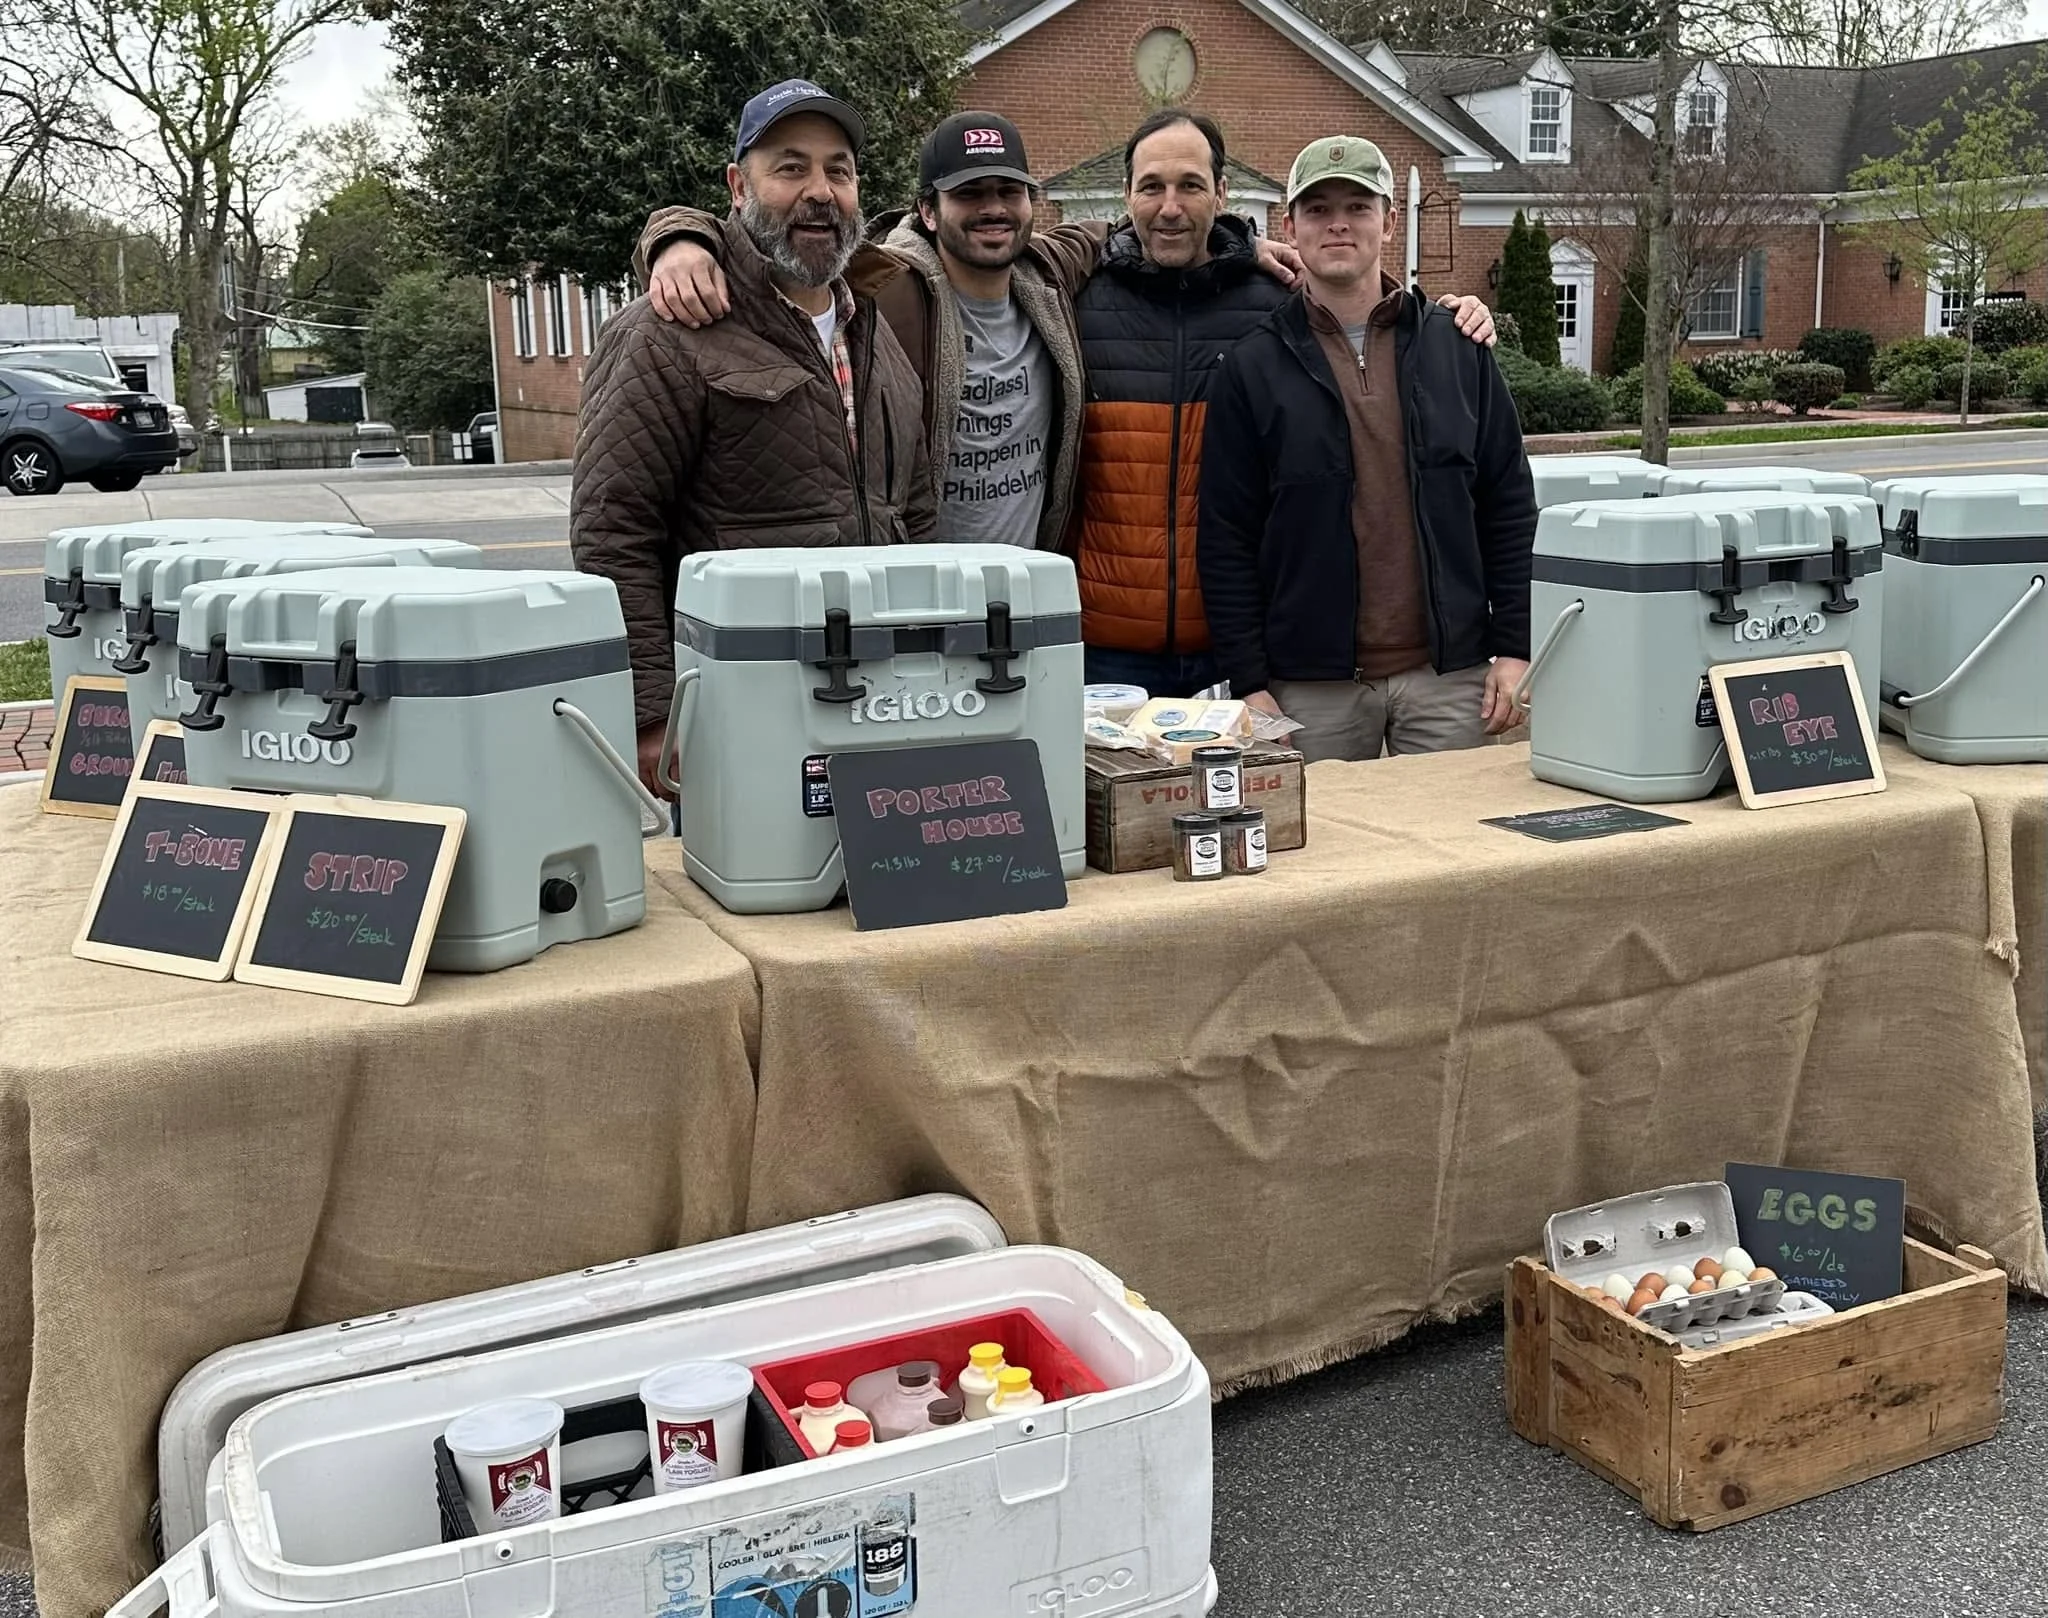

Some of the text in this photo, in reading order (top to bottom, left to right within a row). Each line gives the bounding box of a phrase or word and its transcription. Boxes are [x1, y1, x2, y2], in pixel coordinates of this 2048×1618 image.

[959, 365, 1029, 404] ad[ass]
[956, 408, 1013, 436] hings
[1025, 433, 1041, 455] in
[850, 689, 987, 724] IGLOO
[1749, 692, 1800, 726] RIB
[241, 729, 353, 767] IGLOO
[1783, 716, 1838, 747] EYE
[866, 775, 1012, 819] PORTER
[921, 811, 1025, 844] HOUSE
[145, 829, 246, 871] T-BONE
[303, 851, 409, 895] STRIP
[1757, 1188, 1878, 1232] EGGS
[1814, 1289, 1861, 1303] DAILY
[717, 1555, 755, 1570] COOLER
[813, 1531, 851, 1547] HIELERA
[1026, 1567, 1135, 1616] IGLOO
